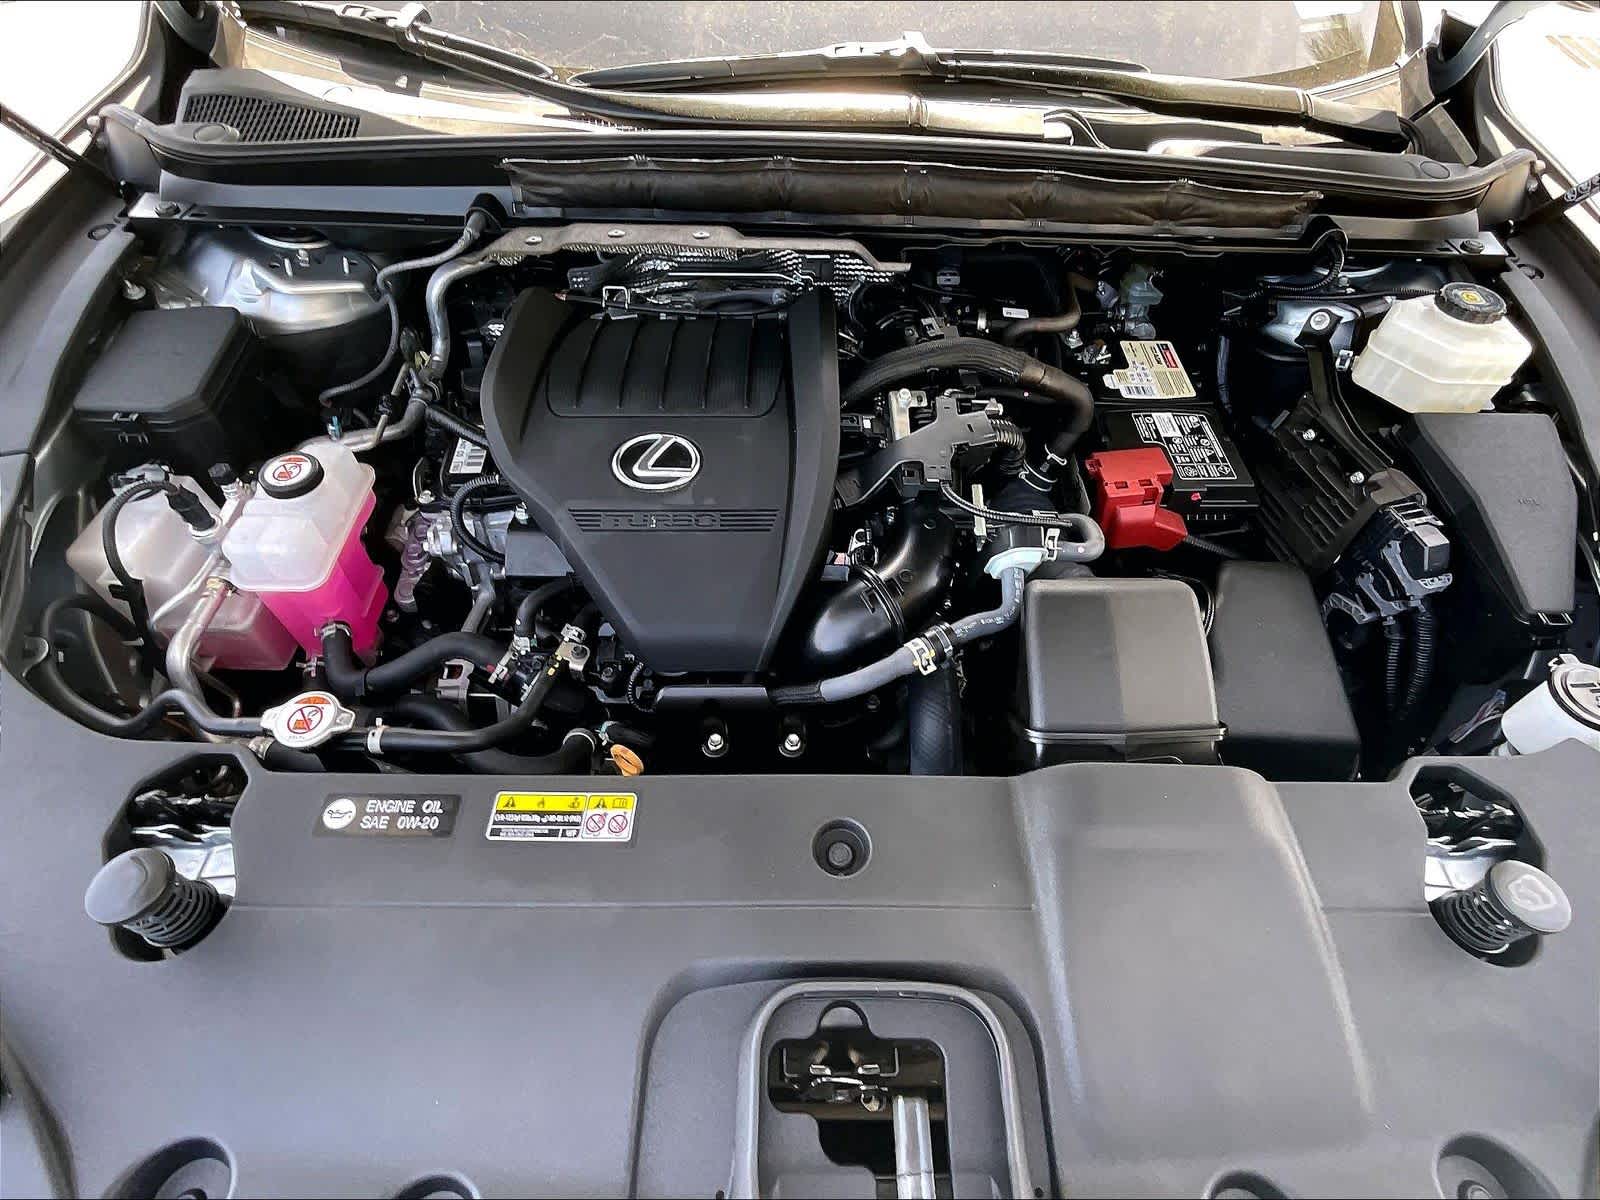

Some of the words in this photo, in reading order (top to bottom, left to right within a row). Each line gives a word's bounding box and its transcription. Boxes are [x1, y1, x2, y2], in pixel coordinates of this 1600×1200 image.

[602, 511, 717, 528] TURBO
[365, 800, 416, 814] ENGINE
[422, 800, 444, 814] OIL
[360, 816, 390, 829] SAE
